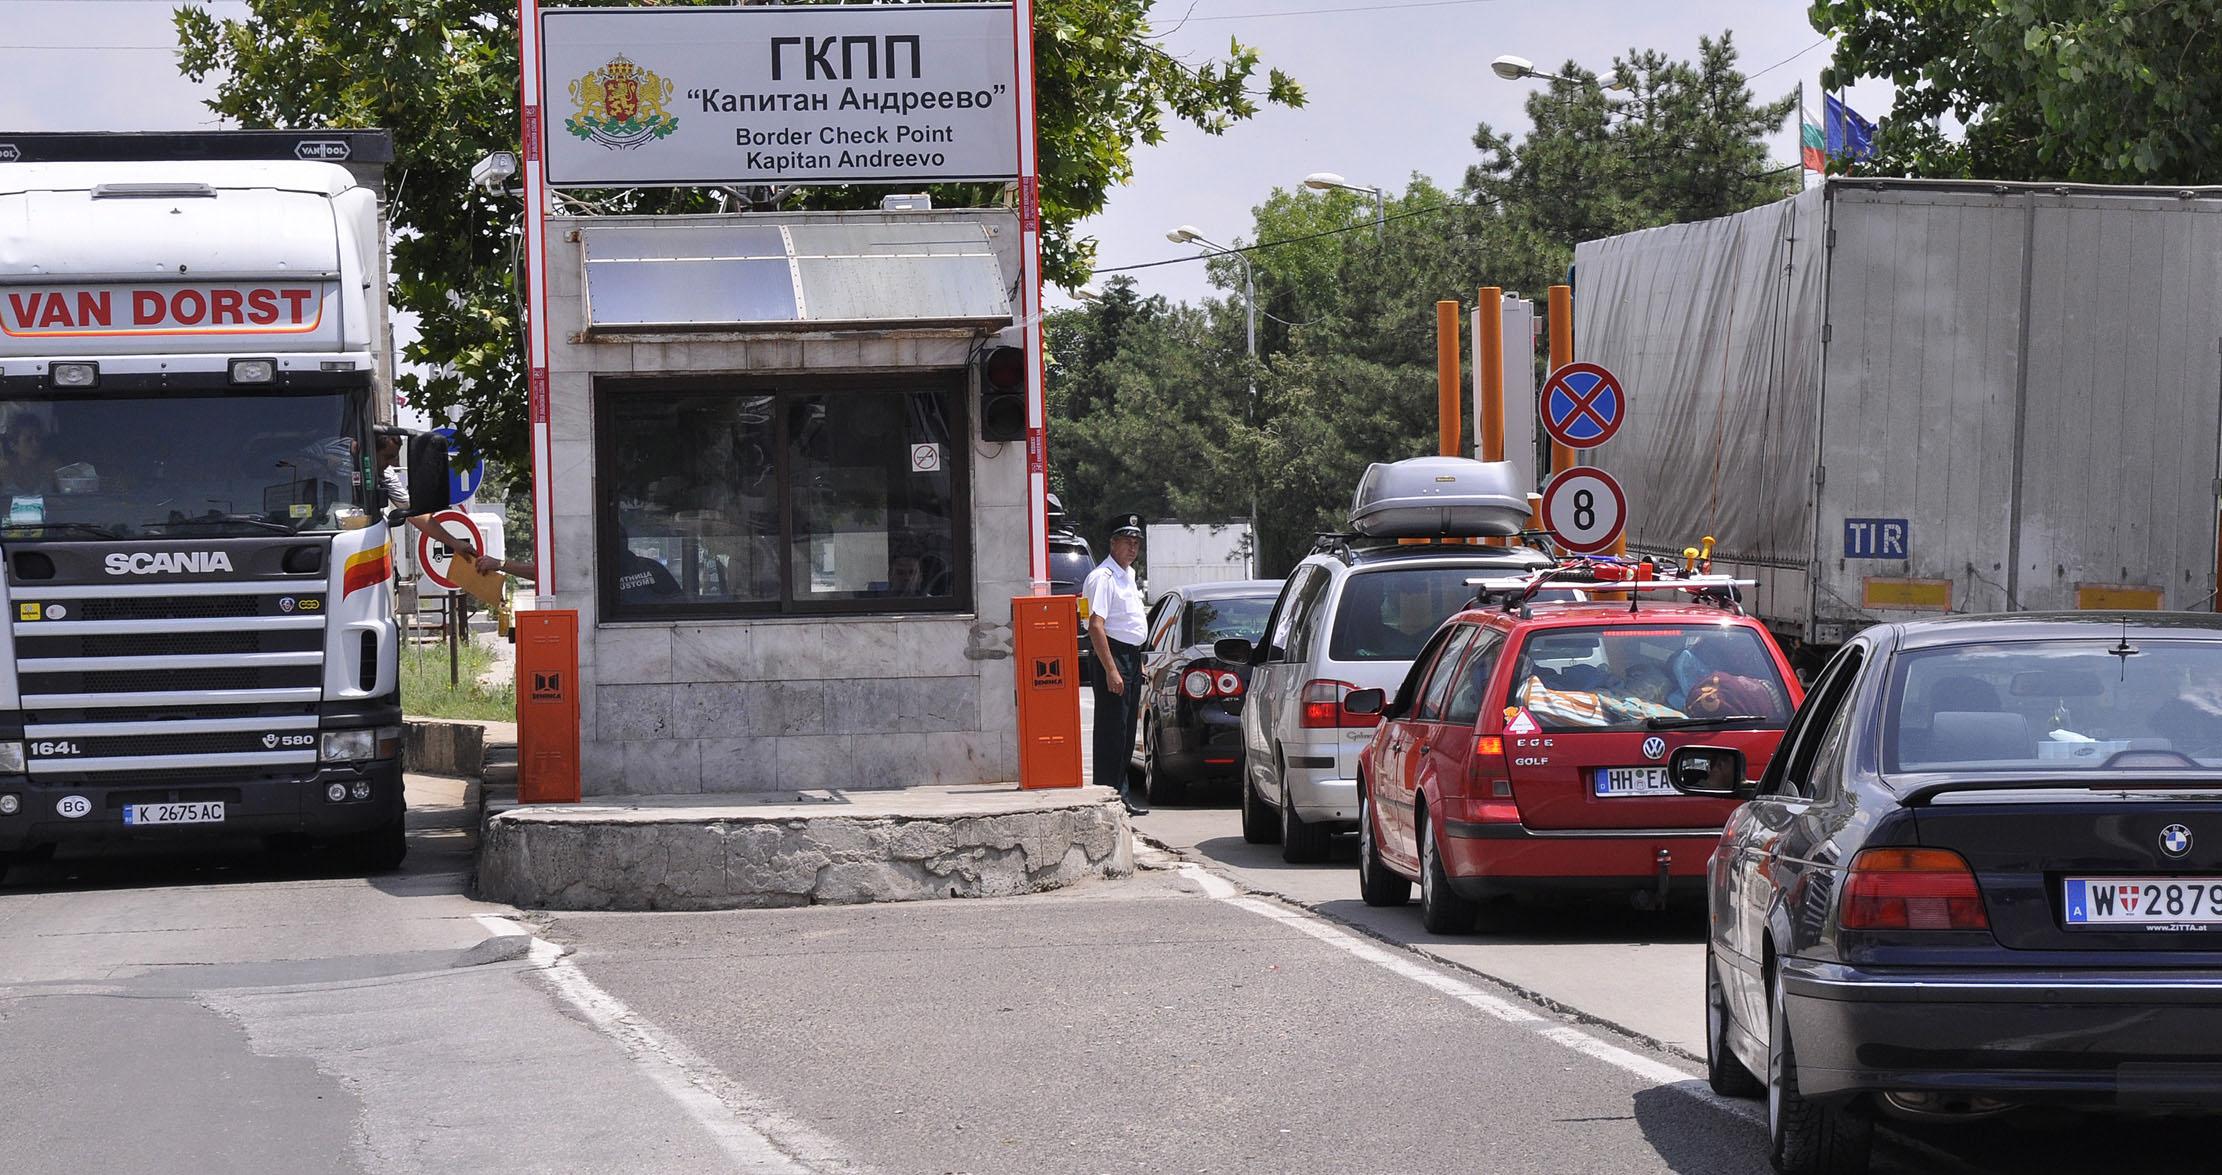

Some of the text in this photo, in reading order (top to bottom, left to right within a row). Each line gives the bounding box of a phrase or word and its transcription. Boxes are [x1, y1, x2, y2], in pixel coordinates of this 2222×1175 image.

[770, 34, 921, 81] ГКПП
[687, 84, 1006, 115] “Капитан Андреево”
[736, 124, 953, 146] Border Check Point
[747, 149, 945, 172] Kapitan Andreevo
[8, 288, 312, 328] VAN DORST
[1573, 489, 1595, 531] 8
[1849, 523, 1903, 554] TIR
[104, 551, 234, 575] SCANIA
[281, 735, 315, 746] 580
[1515, 757, 1549, 766] GOLF
[1609, 770, 1633, 790] HH
[63, 800, 86, 813] BG
[2073, 906, 2082, 916] A
[2092, 885, 2116, 916] W
